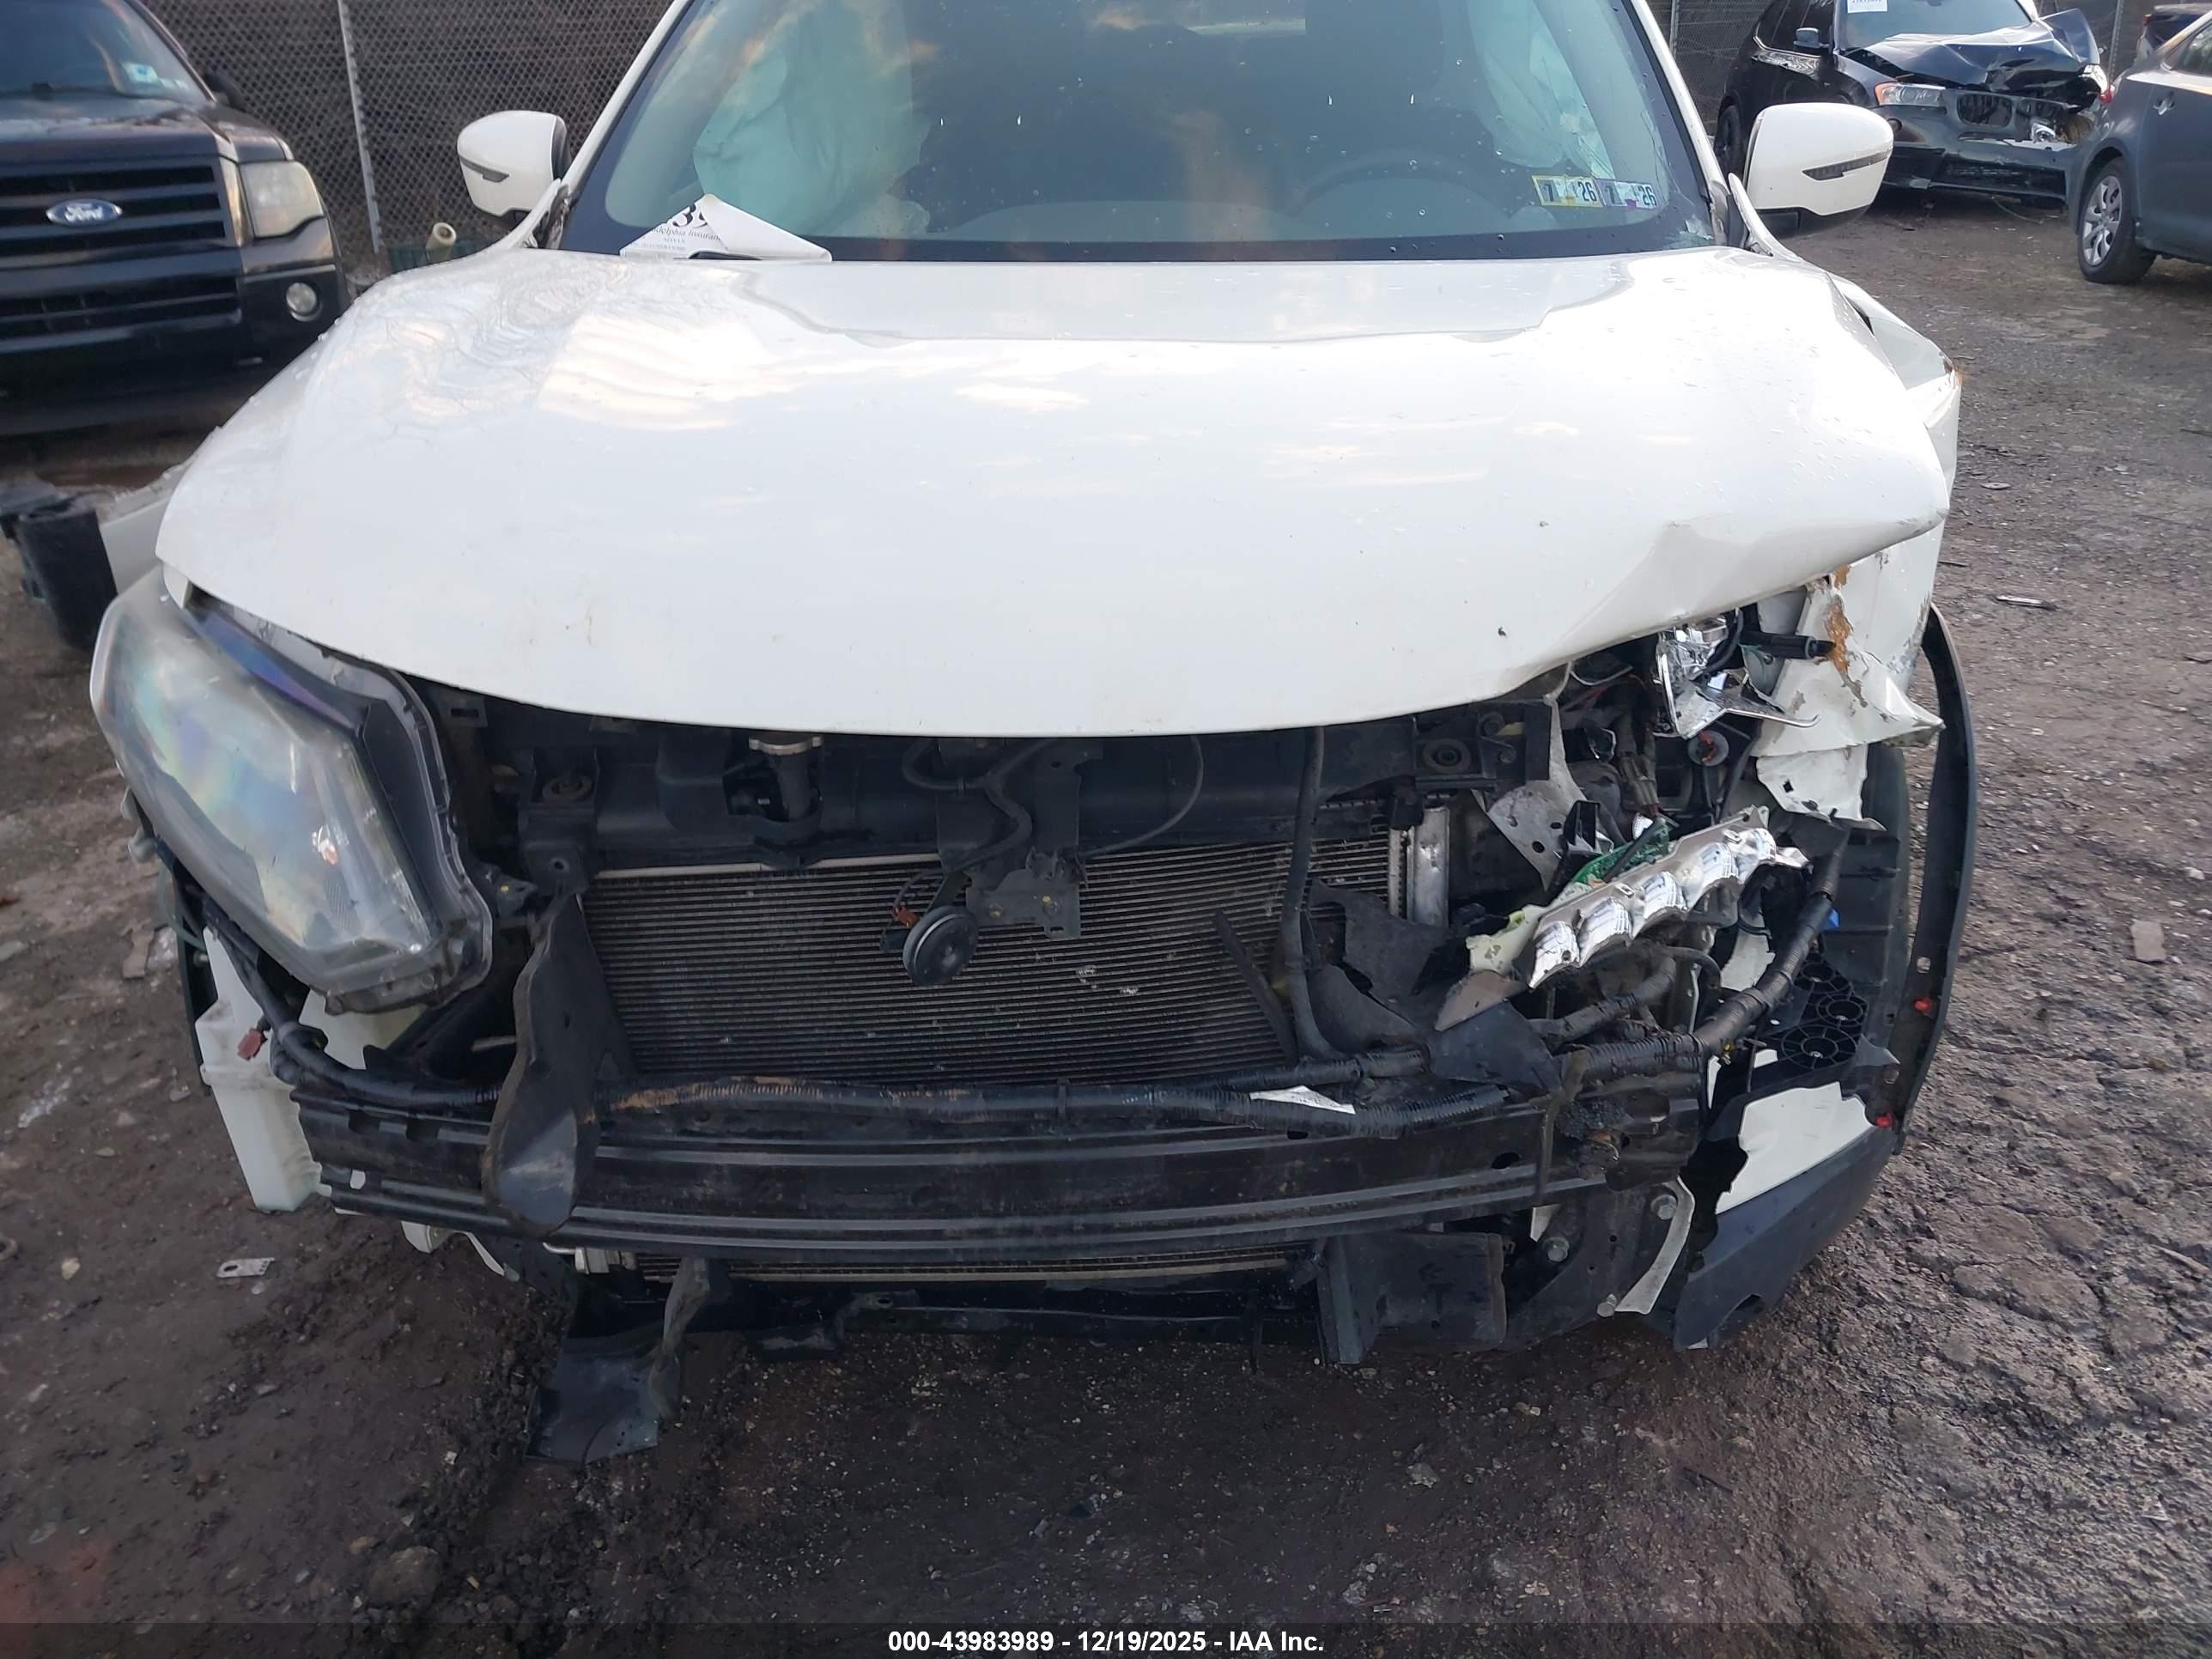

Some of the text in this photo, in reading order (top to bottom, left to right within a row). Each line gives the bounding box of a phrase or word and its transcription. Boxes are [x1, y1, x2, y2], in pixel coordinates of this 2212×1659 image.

[1577, 181, 1597, 202] 26
[1638, 185, 1657, 206] 26
[64, 204, 103, 222] Ford
[688, 230, 721, 241] Insuran
